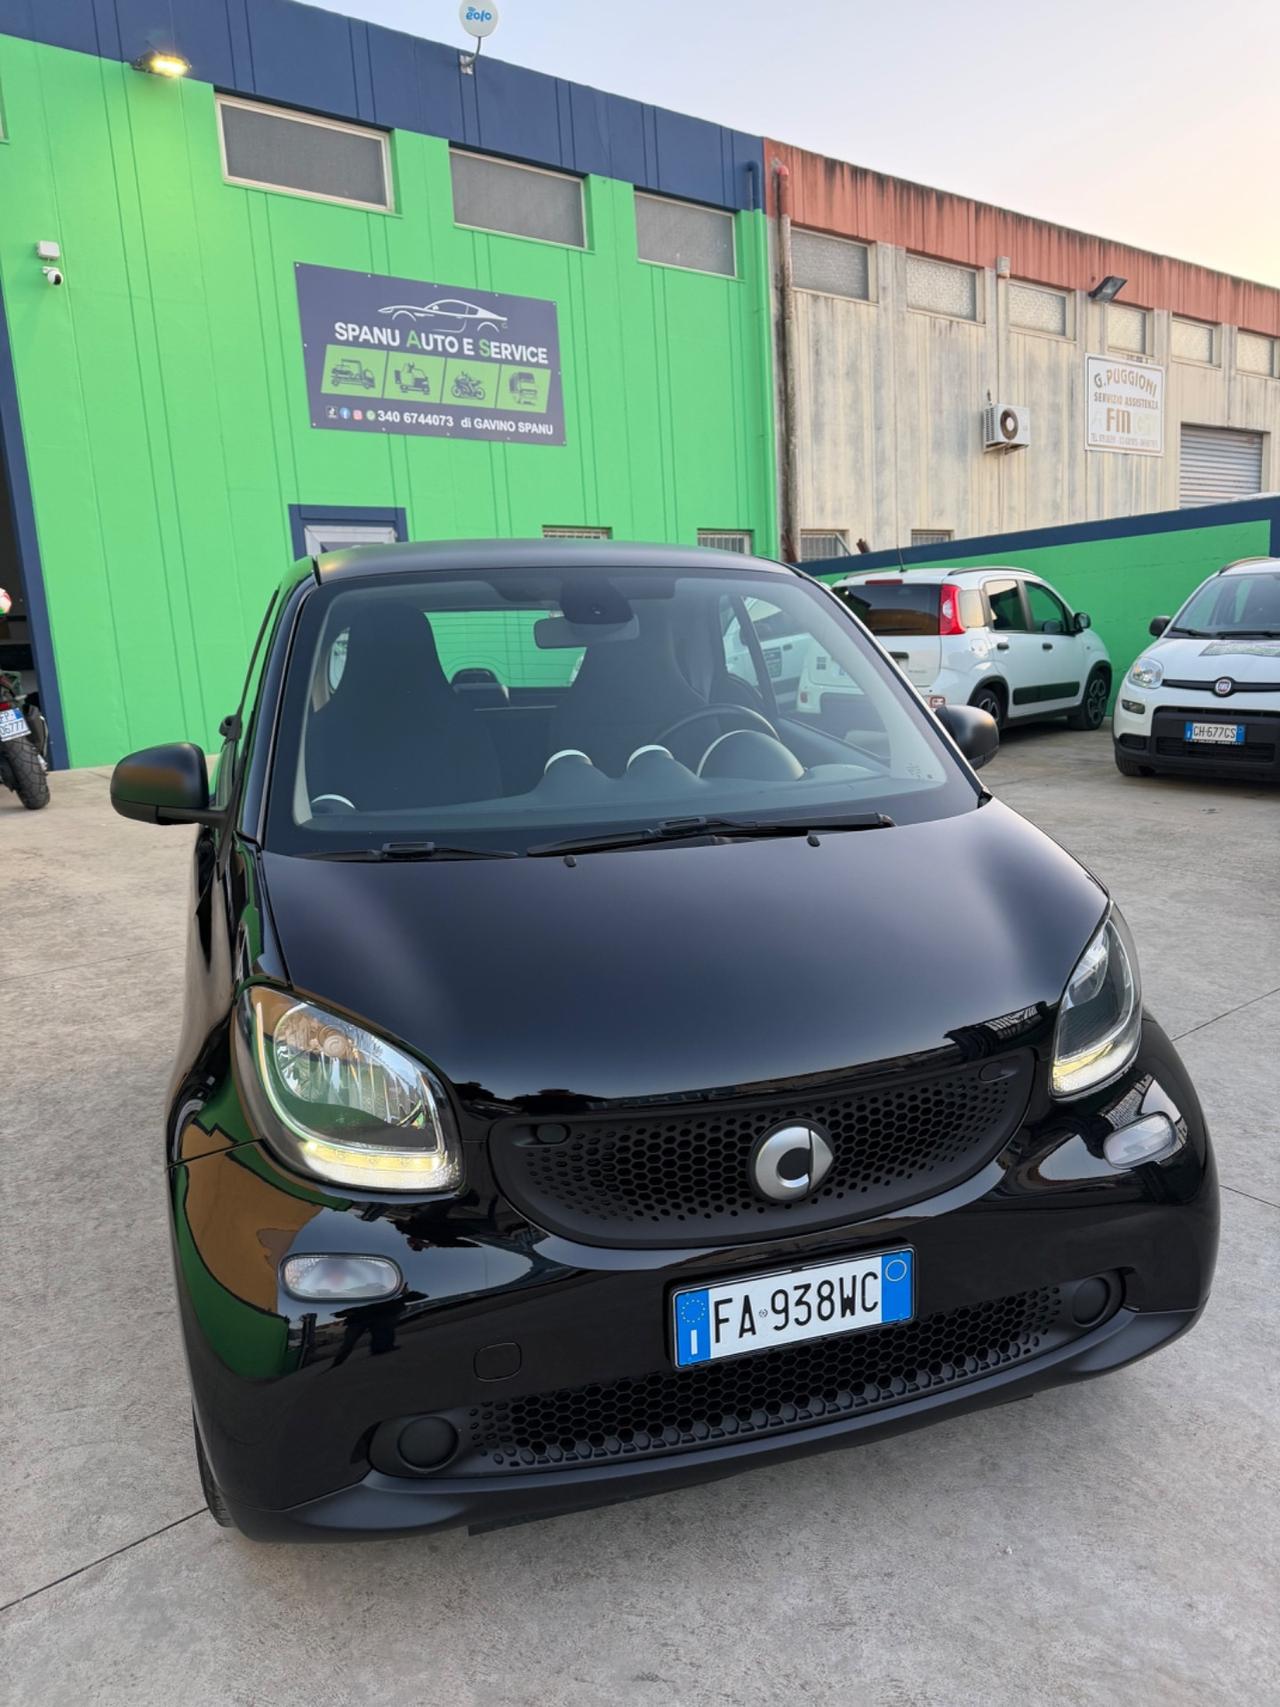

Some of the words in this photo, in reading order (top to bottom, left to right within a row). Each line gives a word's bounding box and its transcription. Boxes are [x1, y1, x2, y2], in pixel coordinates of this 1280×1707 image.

[334, 322, 400, 347] SPANU
[406, 330, 459, 354] AUTO
[462, 338, 475, 356] E
[479, 338, 549, 364] SERVICE
[377, 410, 400, 423] 340
[403, 412, 454, 427] 6744073
[461, 417, 472, 428] di
[473, 419, 517, 432] GAVINO
[518, 422, 553, 435] SPANU
